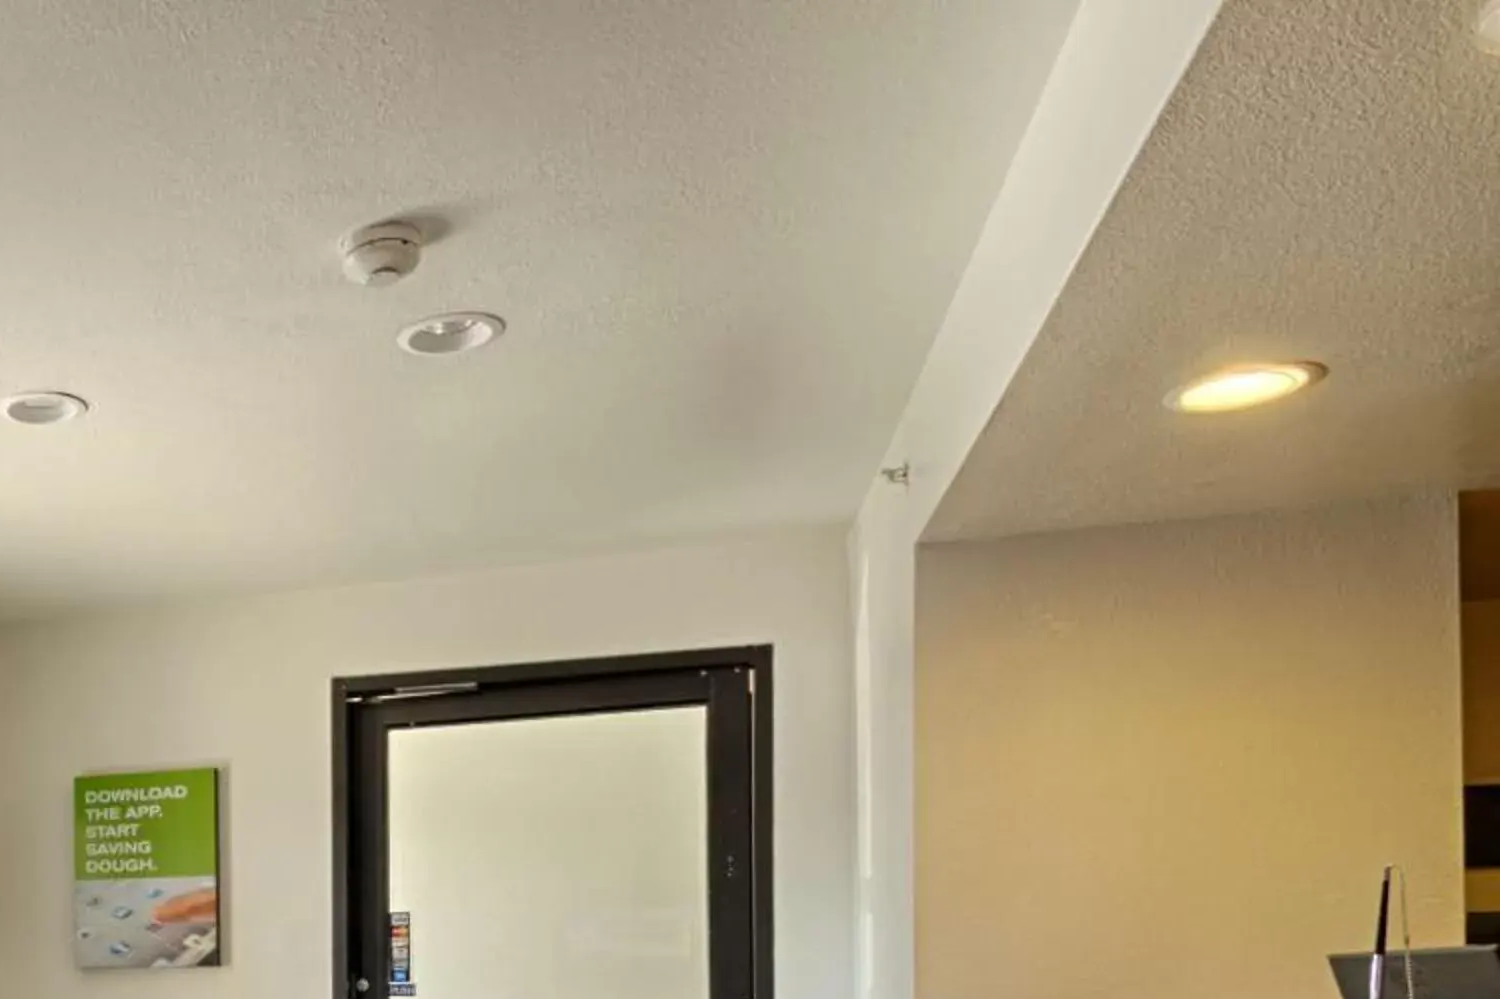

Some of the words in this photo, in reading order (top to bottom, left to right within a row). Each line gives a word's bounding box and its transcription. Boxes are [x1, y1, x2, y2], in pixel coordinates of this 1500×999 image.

[85, 784, 188, 804] DOWNLOAD
[85, 806, 120, 823] THE
[125, 804, 163, 820] APP.
[85, 822, 139, 839] START
[85, 840, 152, 857] SAVING
[85, 857, 158, 874] DOUGH.
